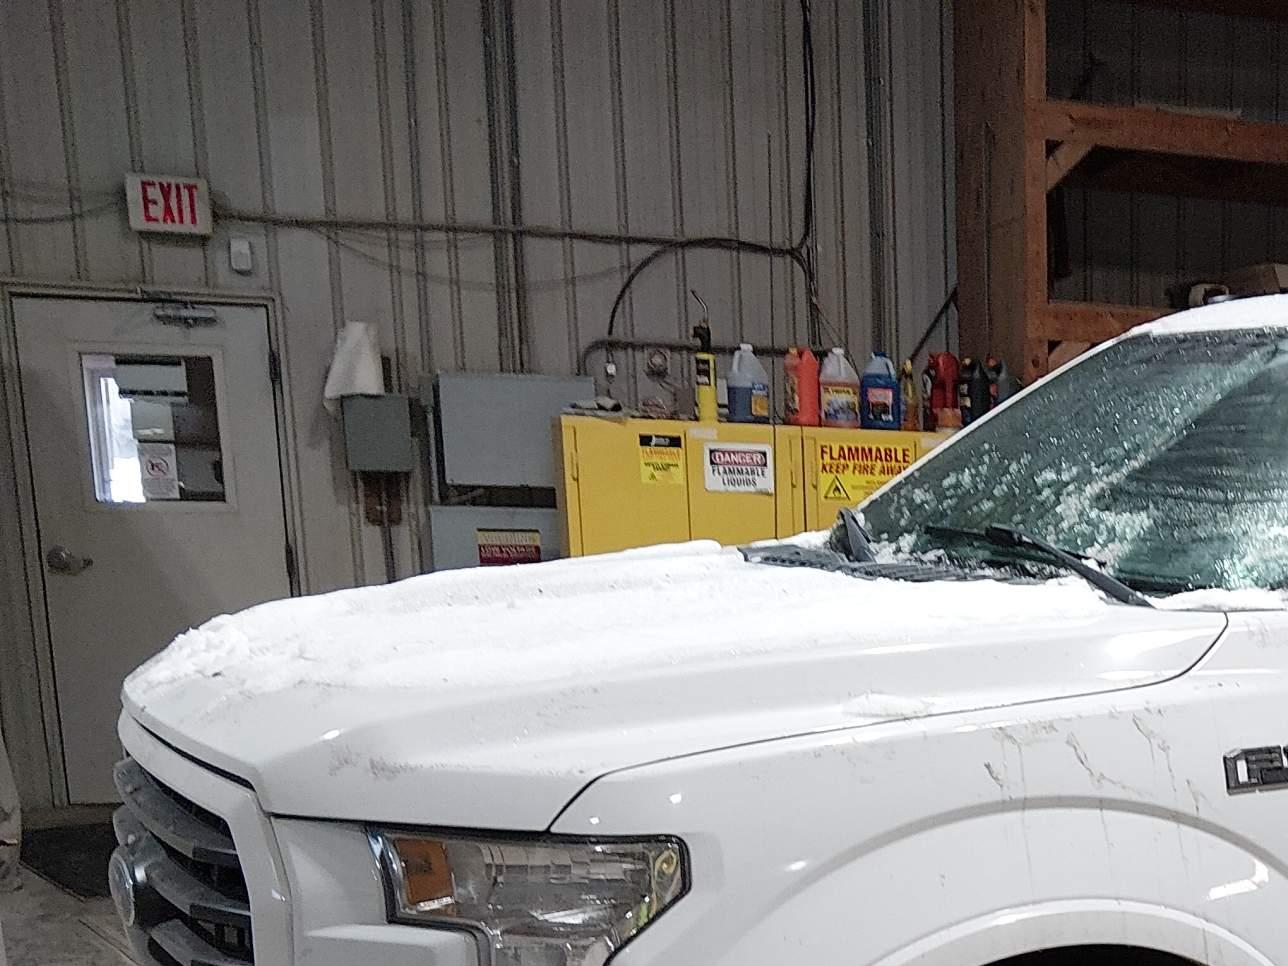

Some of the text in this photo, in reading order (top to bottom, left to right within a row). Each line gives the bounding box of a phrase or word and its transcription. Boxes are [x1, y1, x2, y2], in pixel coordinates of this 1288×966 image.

[141, 180, 198, 225] EXIT
[715, 452, 761, 465] DANGER
[820, 445, 910, 464] FLAMMABLE
[711, 465, 766, 478] FLAMMABLE
[820, 463, 849, 475] KEEP
[852, 464, 877, 476] FIRE
[721, 477, 758, 488] LIQUIDS
